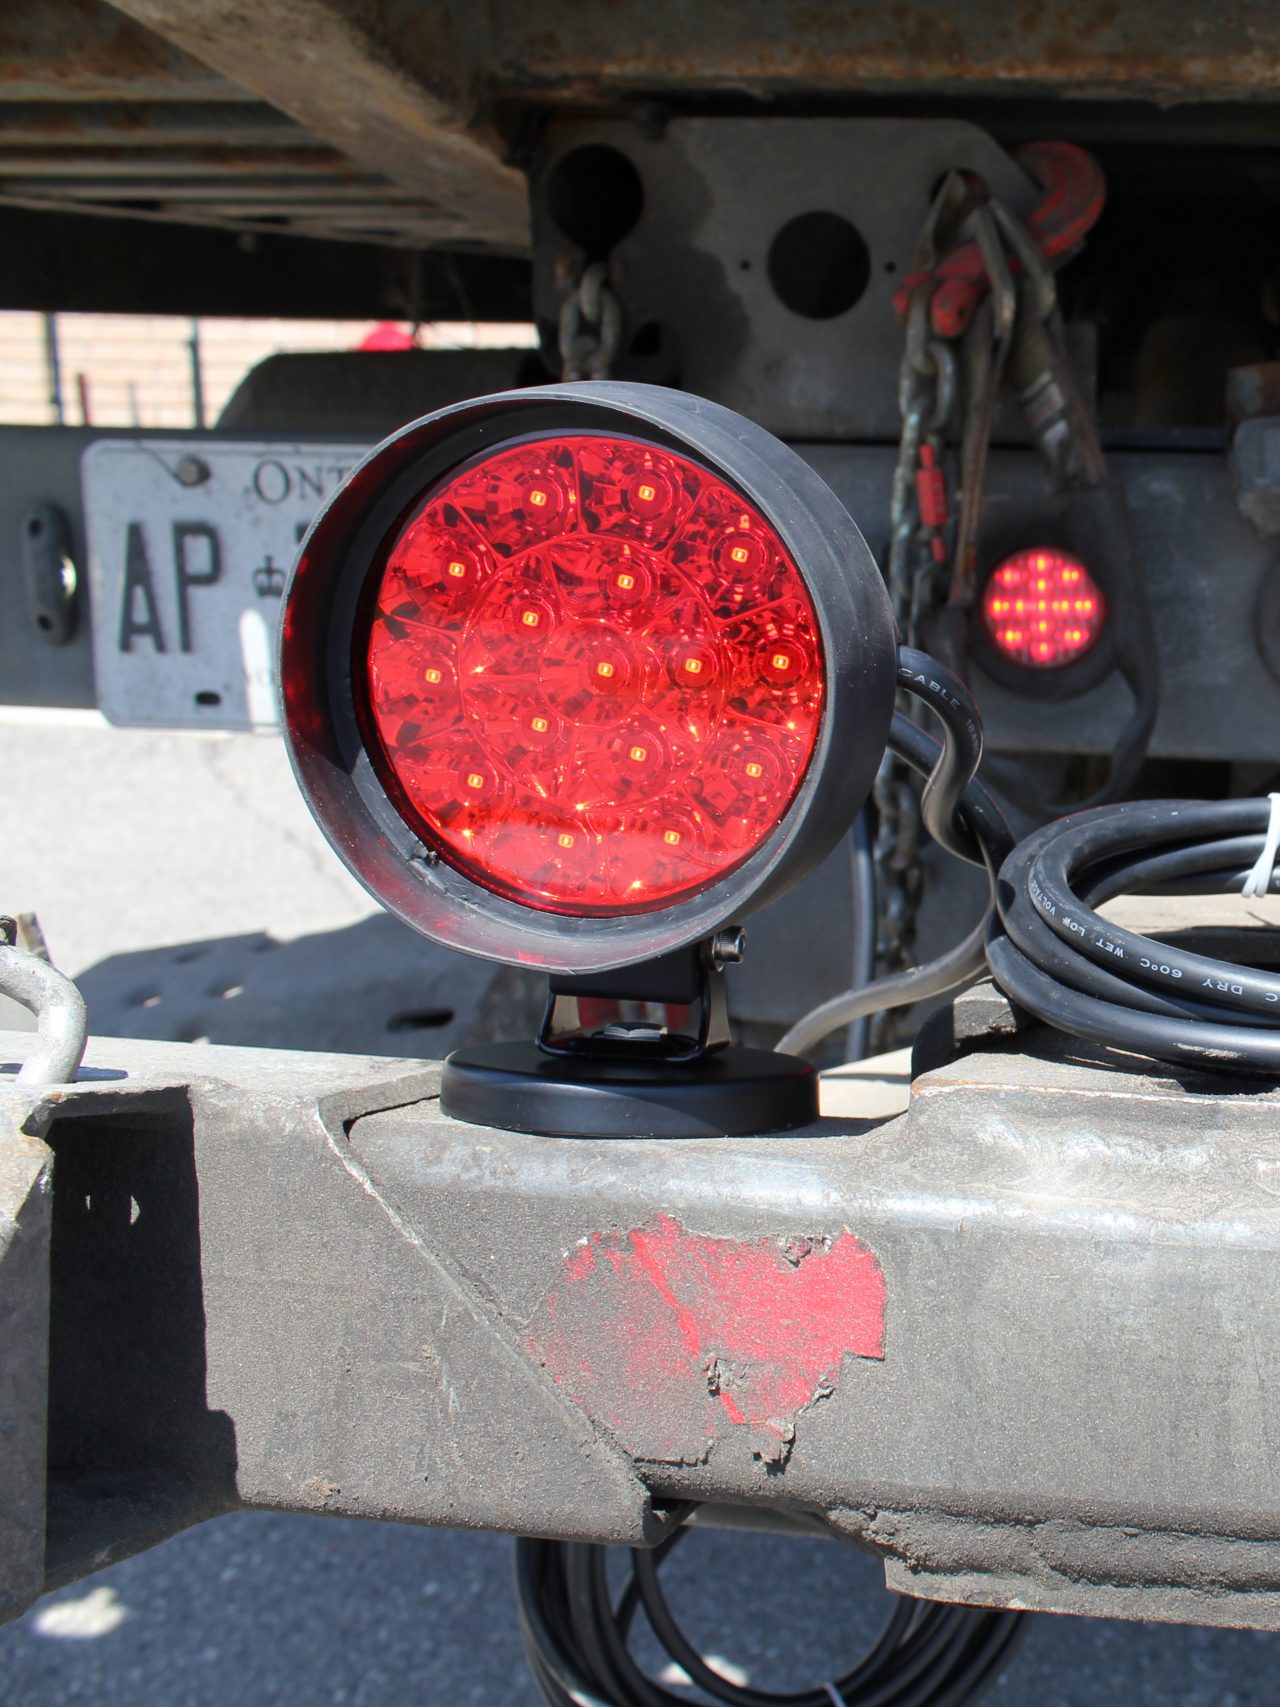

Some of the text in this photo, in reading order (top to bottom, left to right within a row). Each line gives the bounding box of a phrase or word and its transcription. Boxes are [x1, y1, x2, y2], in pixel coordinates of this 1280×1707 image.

[253, 459, 352, 504] ONT
[119, 521, 222, 653] AP
[899, 667, 960, 710] CABLE
[1062, 917, 1088, 937] LOW
[1096, 938, 1124, 958] WET
[1202, 978, 1244, 996] DRY
